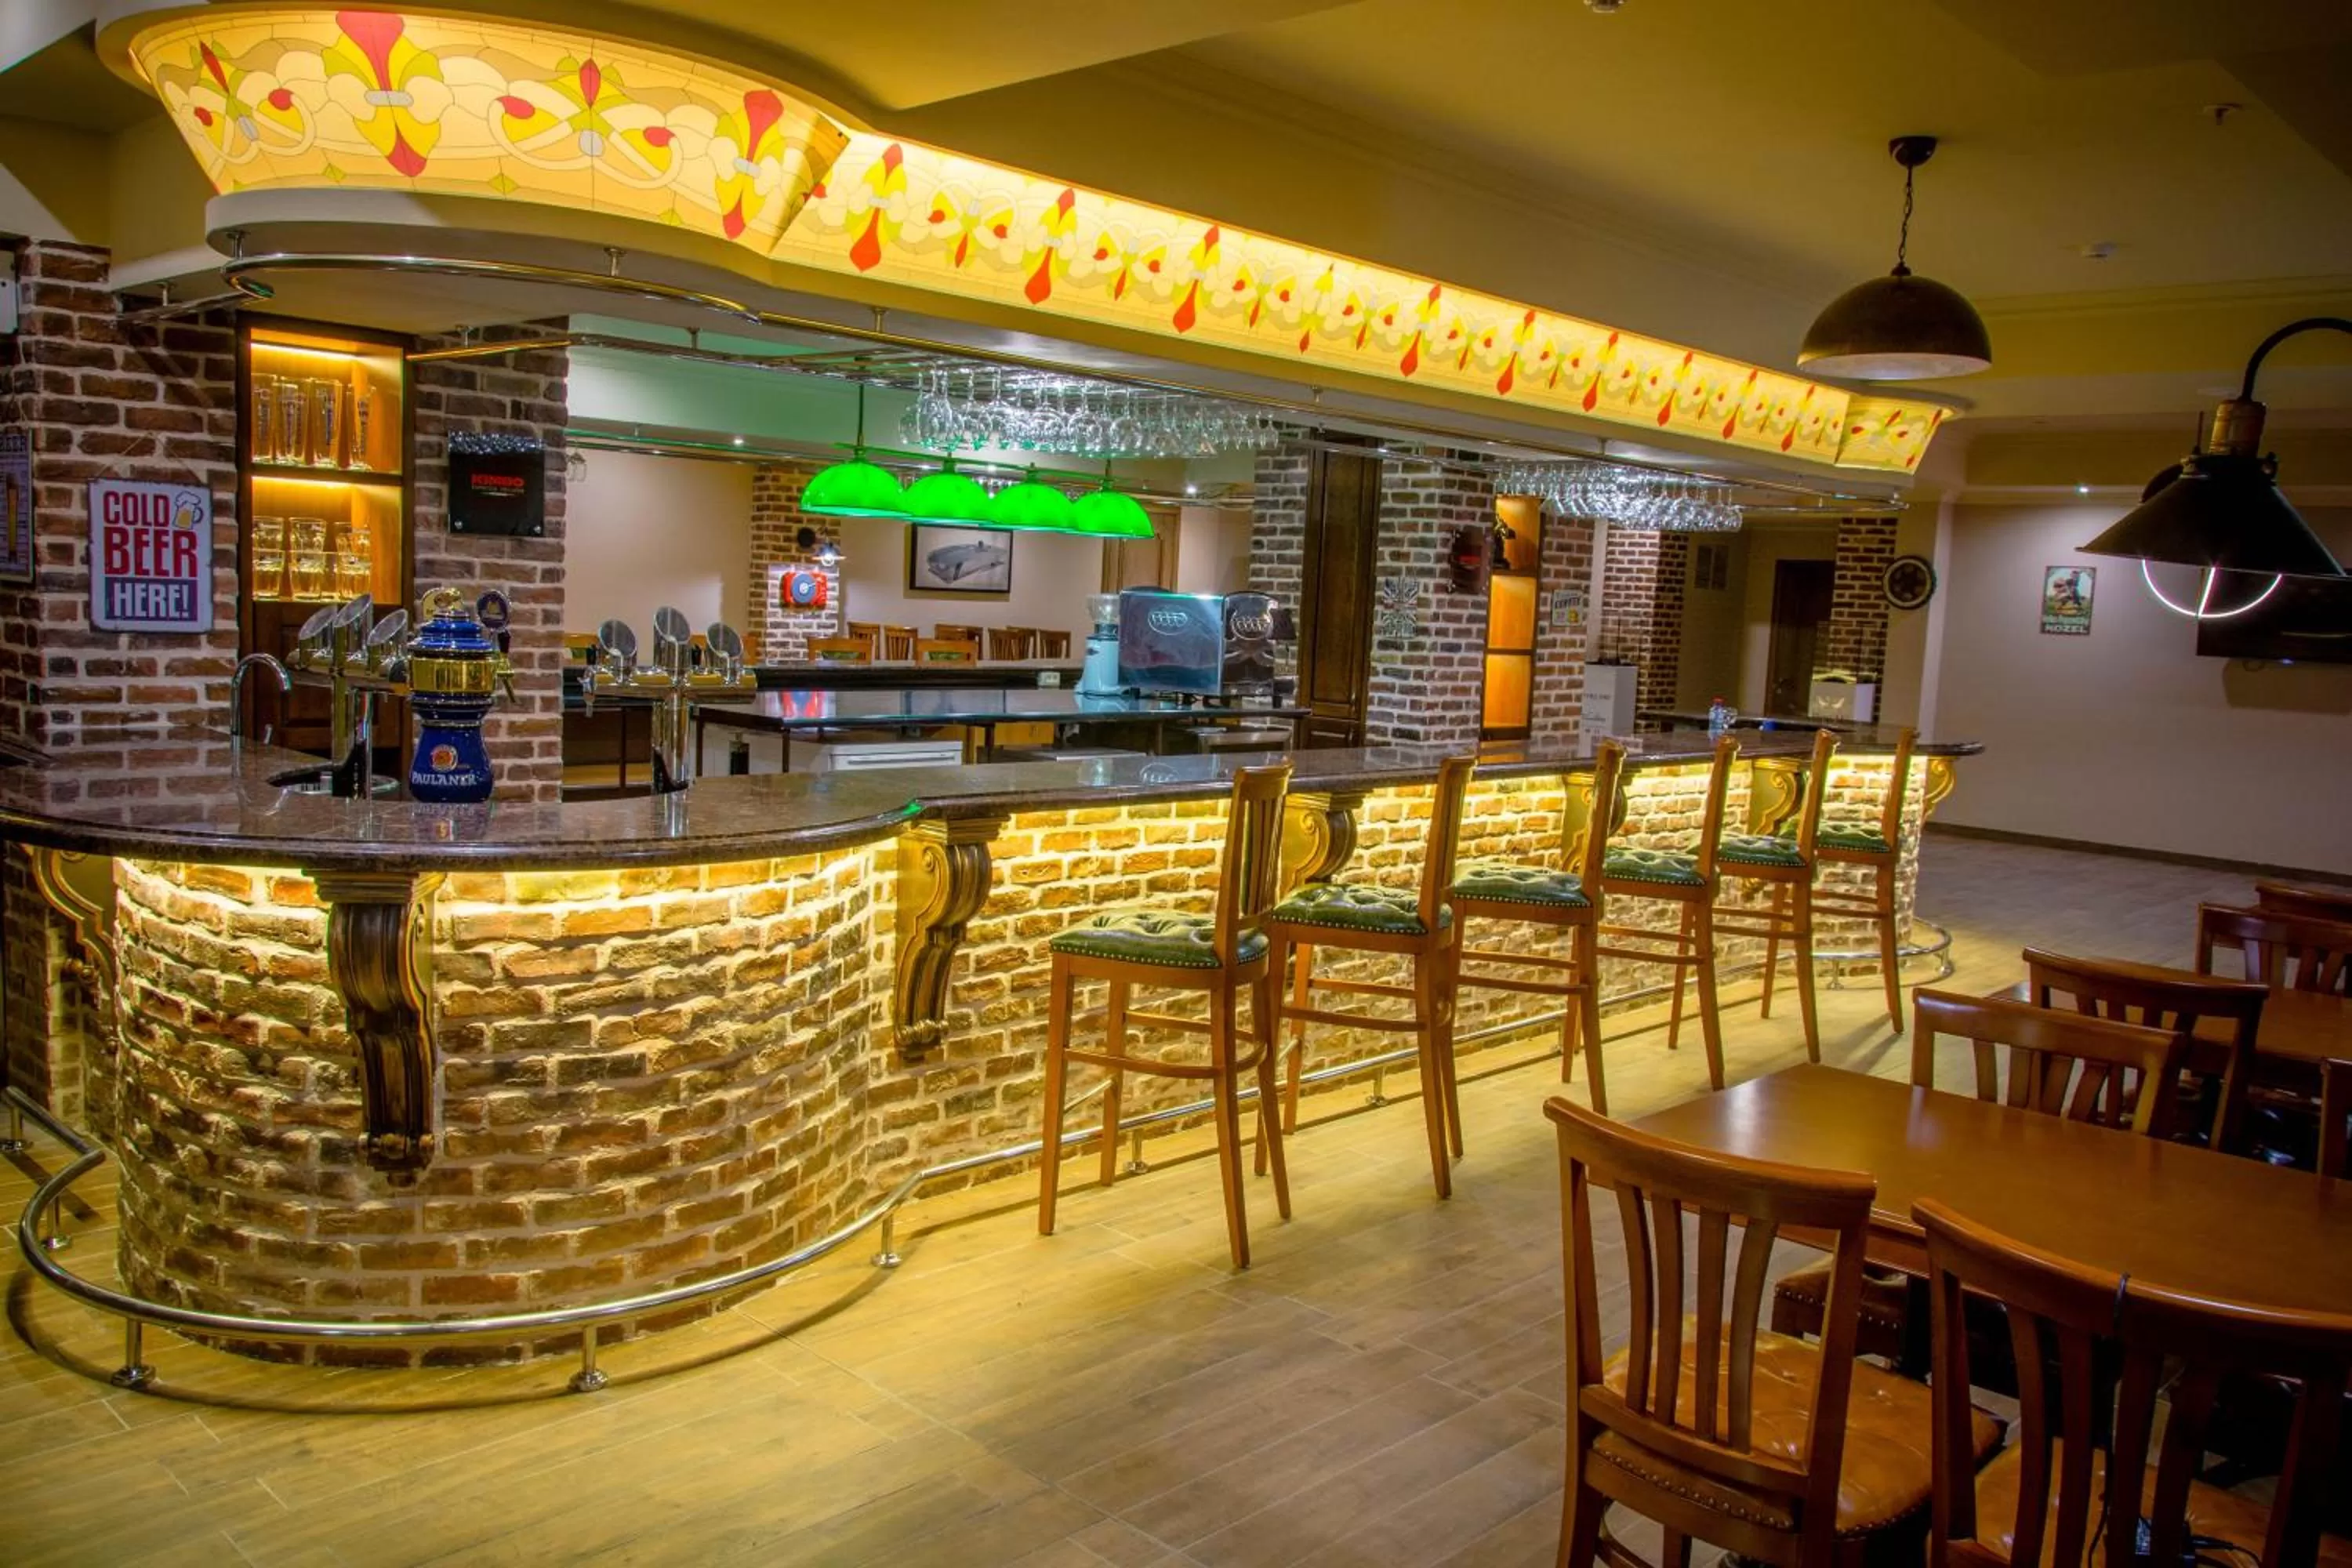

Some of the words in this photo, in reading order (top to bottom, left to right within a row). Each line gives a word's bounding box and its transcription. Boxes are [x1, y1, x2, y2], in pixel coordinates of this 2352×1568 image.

[470, 474, 524, 487] KIMBO
[103, 491, 170, 528] COLD
[103, 526, 198, 578] BEER
[113, 582, 190, 619] HERE!
[411, 771, 477, 786] PAULANER
